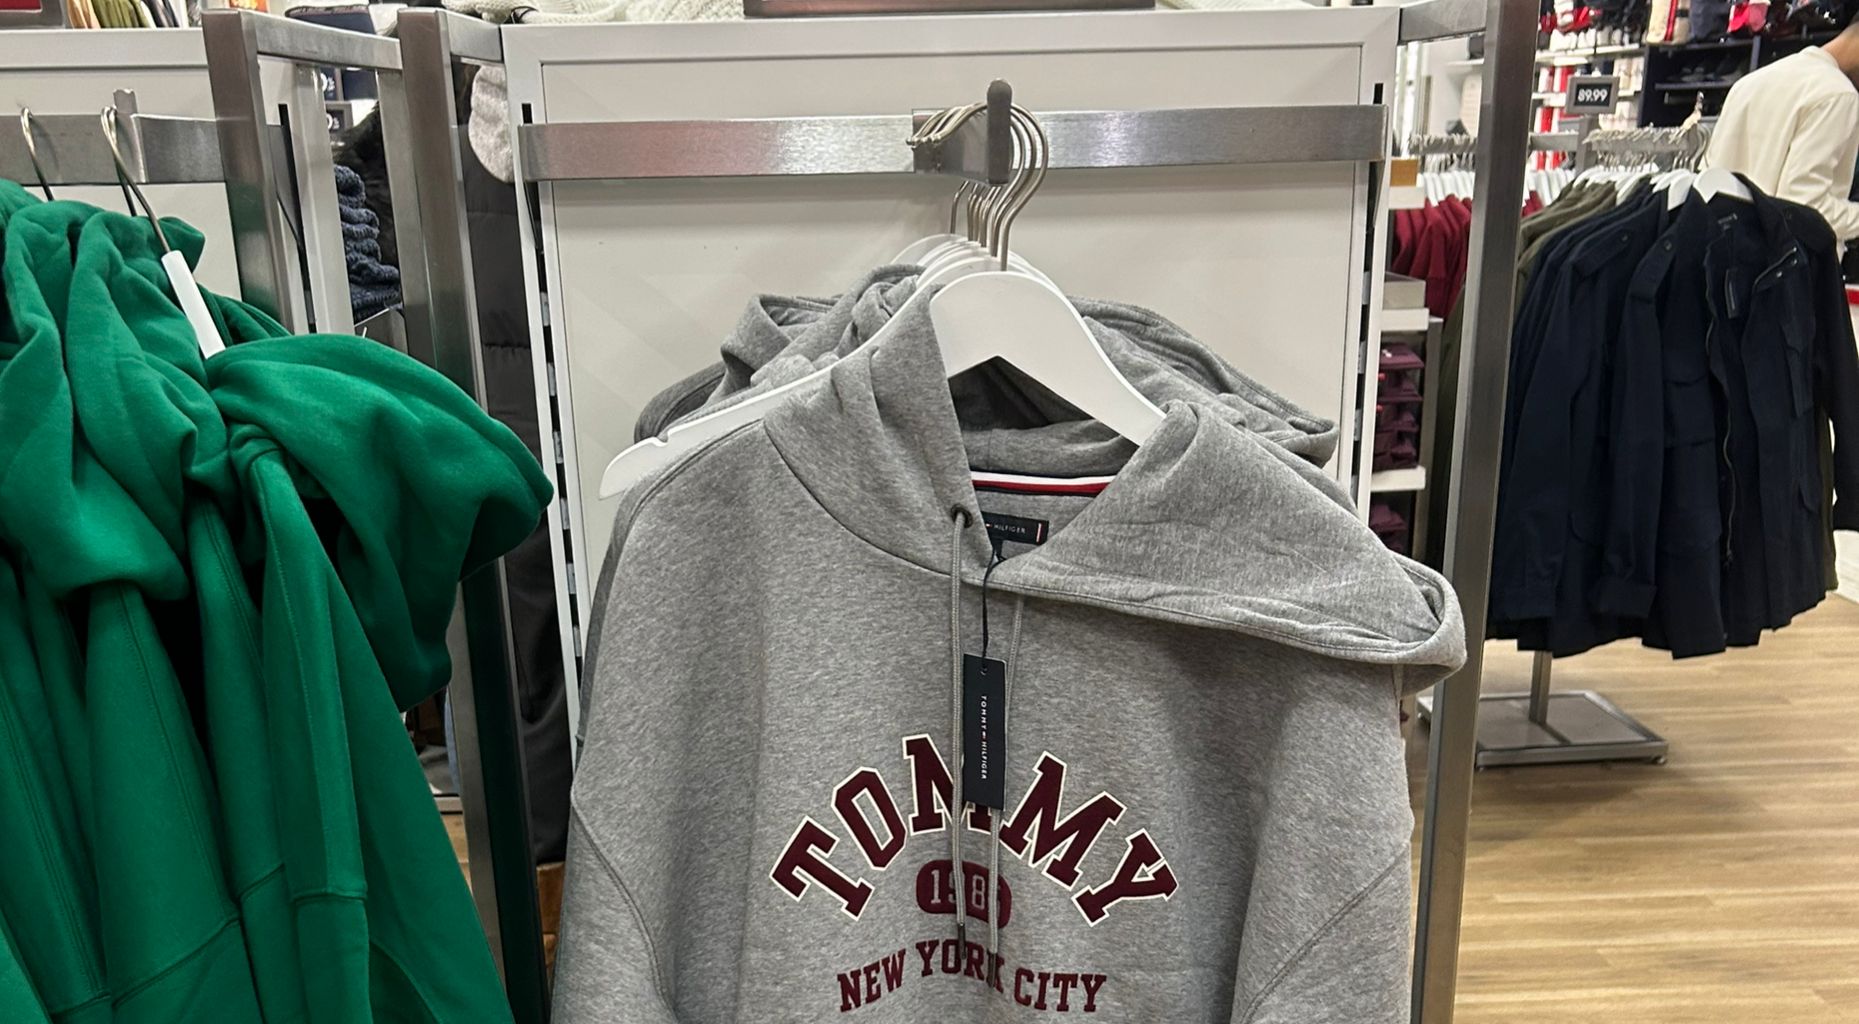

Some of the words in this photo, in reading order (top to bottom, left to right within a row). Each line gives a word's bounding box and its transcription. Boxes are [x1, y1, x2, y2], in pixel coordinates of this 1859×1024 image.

[1577, 88, 1608, 102] 89.99
[993, 523, 1026, 534] HILFIGER
[837, 948, 906, 1013] NEW
[1013, 967, 1107, 1012] CITY
